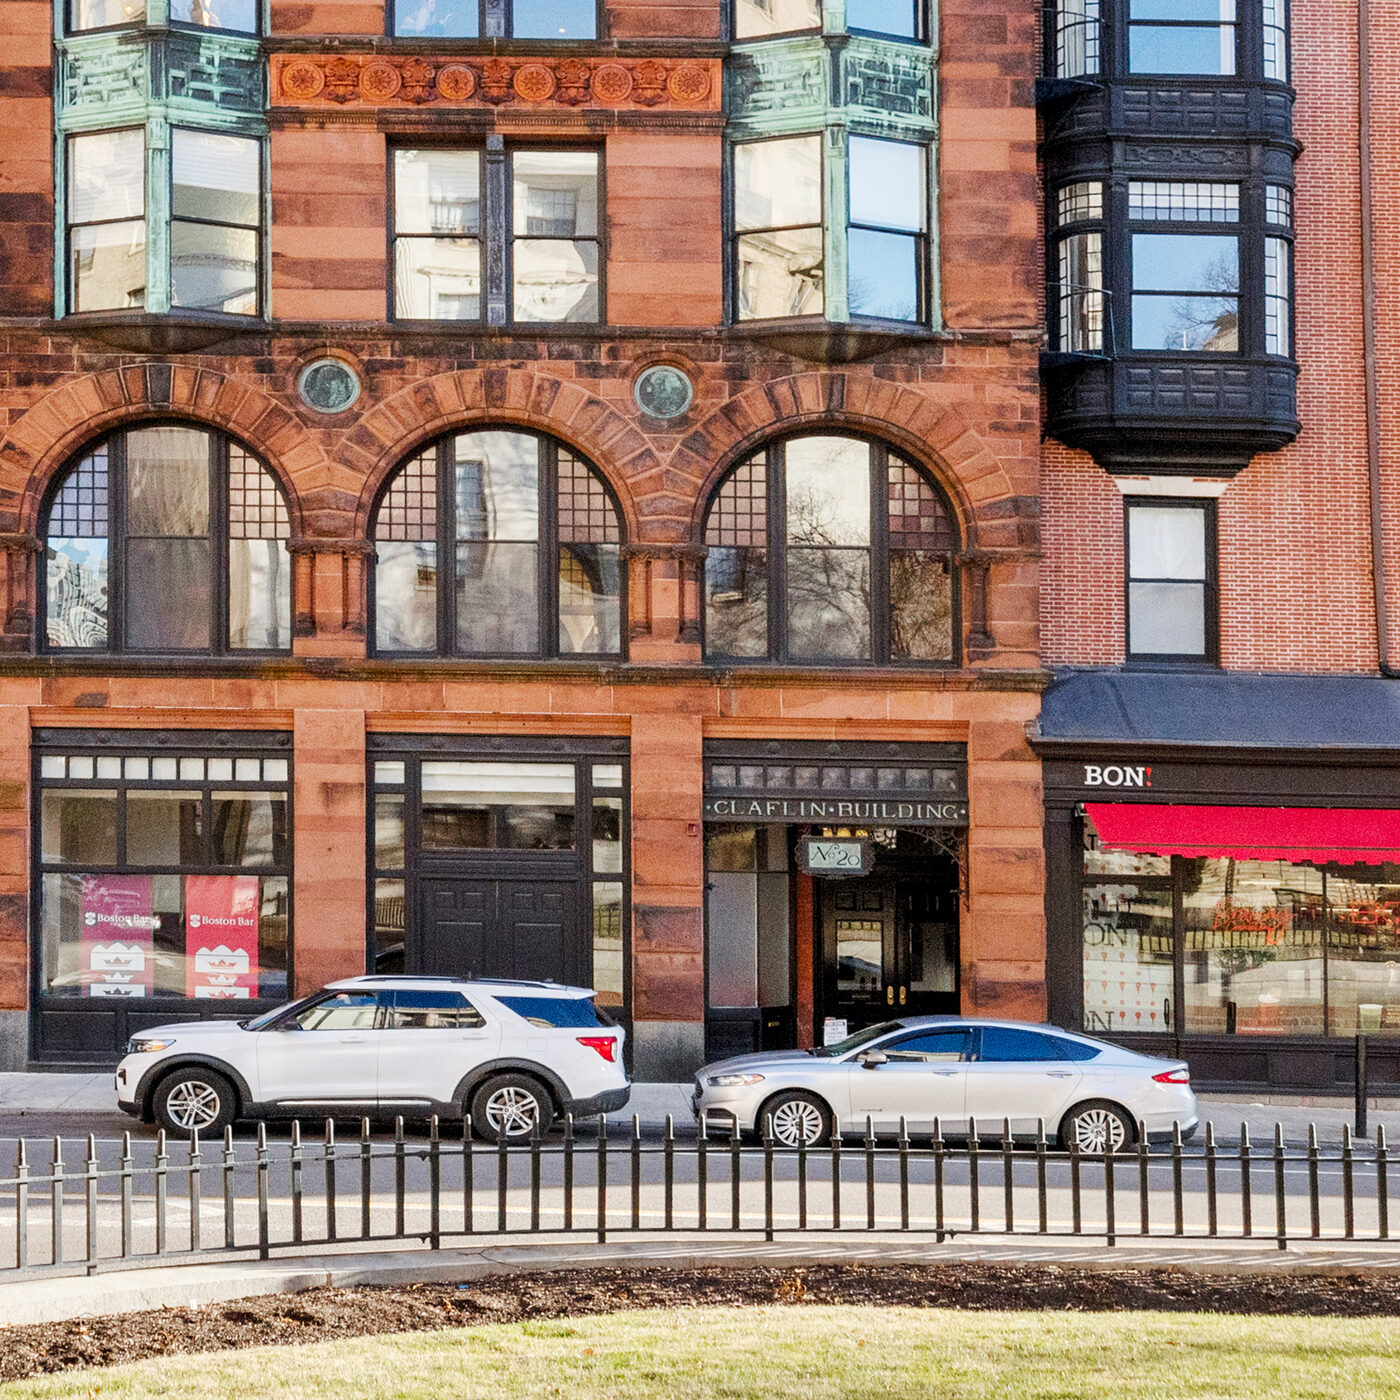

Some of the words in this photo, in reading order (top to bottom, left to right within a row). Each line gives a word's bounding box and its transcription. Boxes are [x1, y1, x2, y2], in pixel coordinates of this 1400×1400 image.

[1084, 765, 1153, 787] BON!
[713, 800, 827, 817] CLAFLIN
[838, 802, 959, 820] BUILDING
[837, 850, 860, 866] 20
[97, 913, 131, 924] Boston
[133, 914, 151, 925] Bar
[202, 916, 236, 926] Boston
[238, 917, 254, 927] Bar
